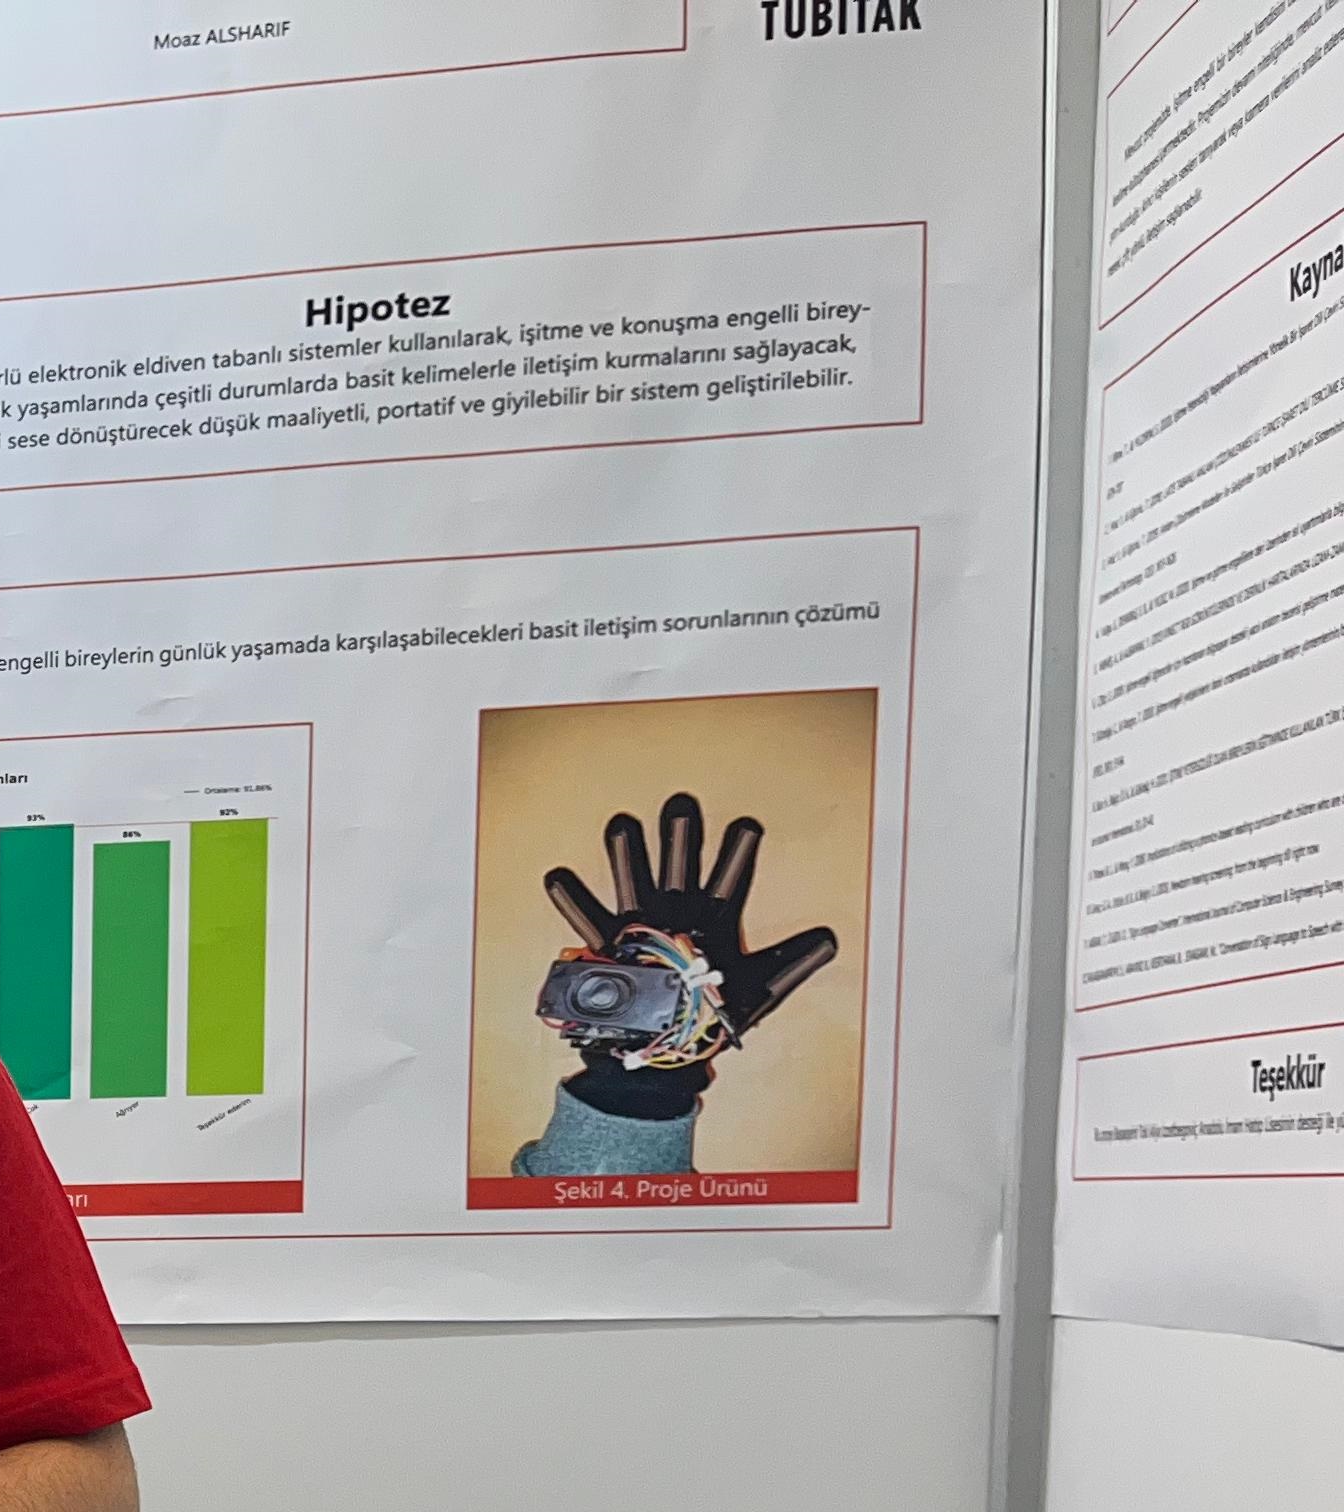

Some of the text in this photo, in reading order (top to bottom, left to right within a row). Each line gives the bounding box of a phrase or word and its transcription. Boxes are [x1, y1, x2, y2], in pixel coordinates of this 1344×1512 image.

[153, 19, 292, 51] Moaz ALSHARIF
[305, 291, 452, 333] Hipotez
[27, 358, 128, 385] elektronik
[132, 354, 206, 377] eldiven
[211, 344, 283, 370] tabanlı
[287, 336, 383, 363] sistemler
[388, 325, 513, 354] kullanılarak,
[519, 322, 584, 347] işitme
[589, 321, 615, 338] ve
[620, 313, 720, 337] konuşma
[725, 302, 800, 332] engelli
[806, 300, 872, 324] birey-
[16, 389, 149, 423] yaşamlarında
[154, 383, 213, 412] çeşitli
[217, 372, 339, 402] durumlarda
[345, 367, 396, 390] basit
[401, 358, 517, 386] kelimelerle
[522, 352, 599, 378] iletişim
[604, 345, 727, 370] kurmalarını
[732, 332, 857, 365] sağlayacak,
[64, 645, 155, 671] bireylerin
[158, 640, 227, 668] günlük
[230, 634, 331, 664] yaşamada
[335, 622, 524, 655] karşılaşabilecekleri
[528, 619, 579, 641] basit
[583, 615, 658, 640] iletişim
[662, 608, 790, 633] sorunlarının
[794, 600, 881, 628] çözümü
[1250, 1053, 1326, 1101] Teşekkür
[553, 1173, 769, 1204] Şekil 4. Proje Ürünü
